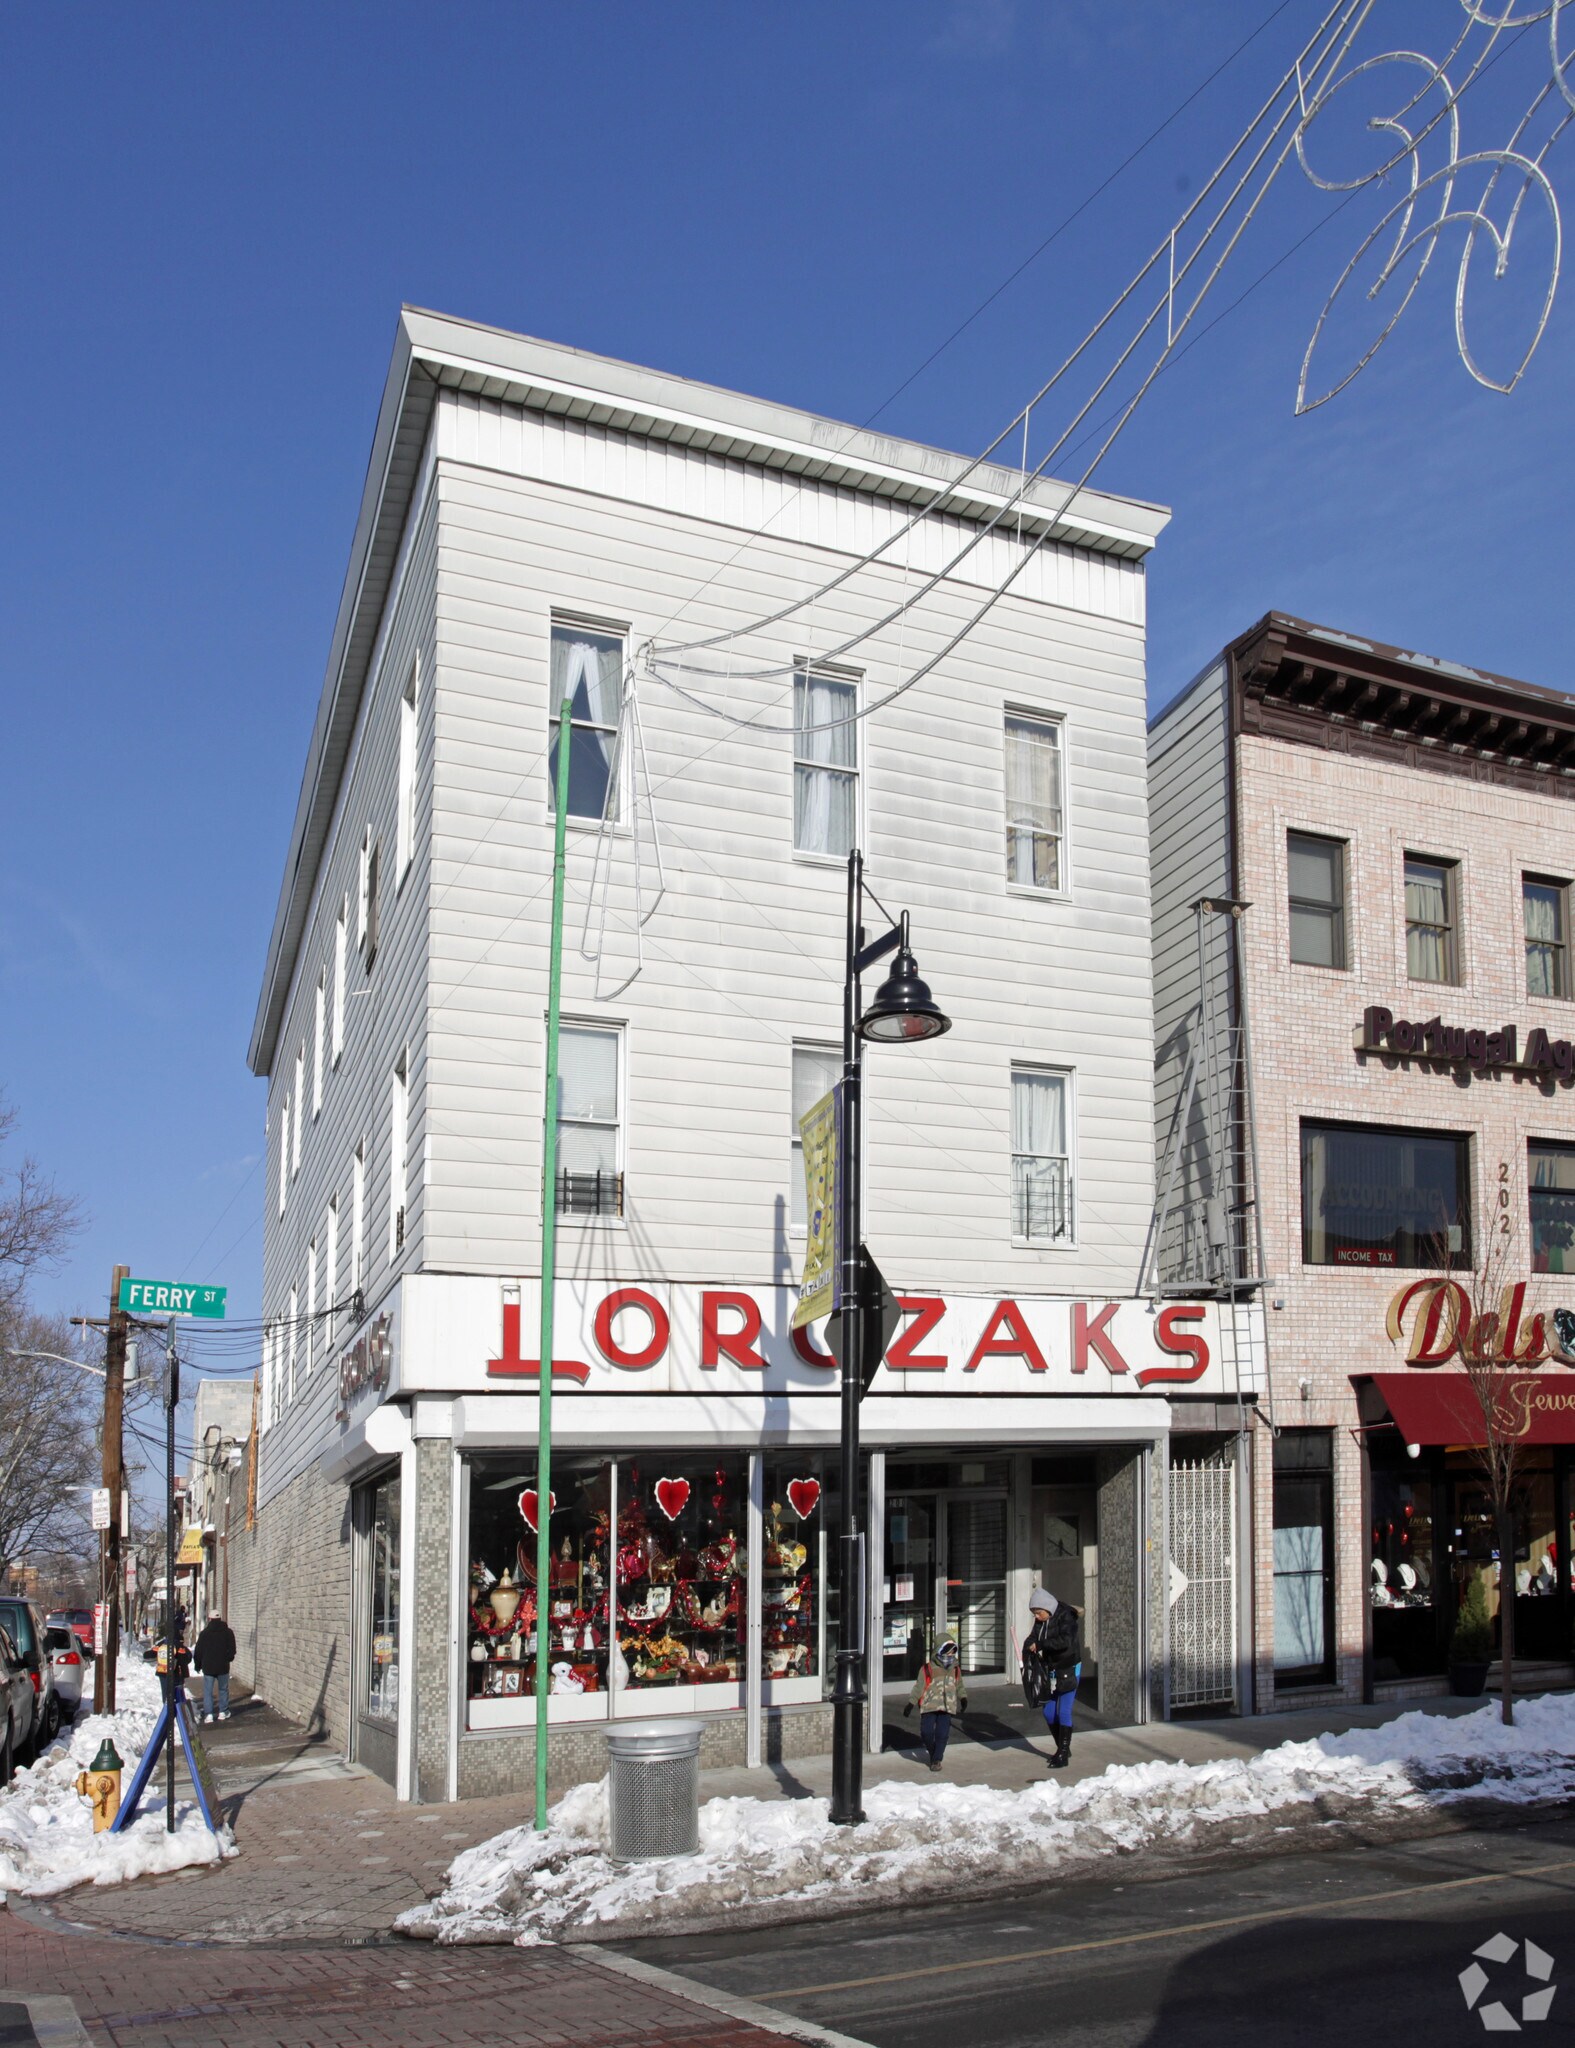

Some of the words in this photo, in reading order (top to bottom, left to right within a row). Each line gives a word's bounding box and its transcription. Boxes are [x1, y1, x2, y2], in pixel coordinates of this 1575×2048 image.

[1363, 1004, 1518, 1072] Portugal
[1522, 1027, 1575, 1081] Ag
[1497, 1162, 1511, 1235] 202
[1337, 1250, 1371, 1263] INCOME
[1377, 1251, 1394, 1263] TAX
[129, 1283, 197, 1310] FERRY
[203, 1290, 217, 1303] ST
[486, 1285, 1211, 1390] LORZAKS
